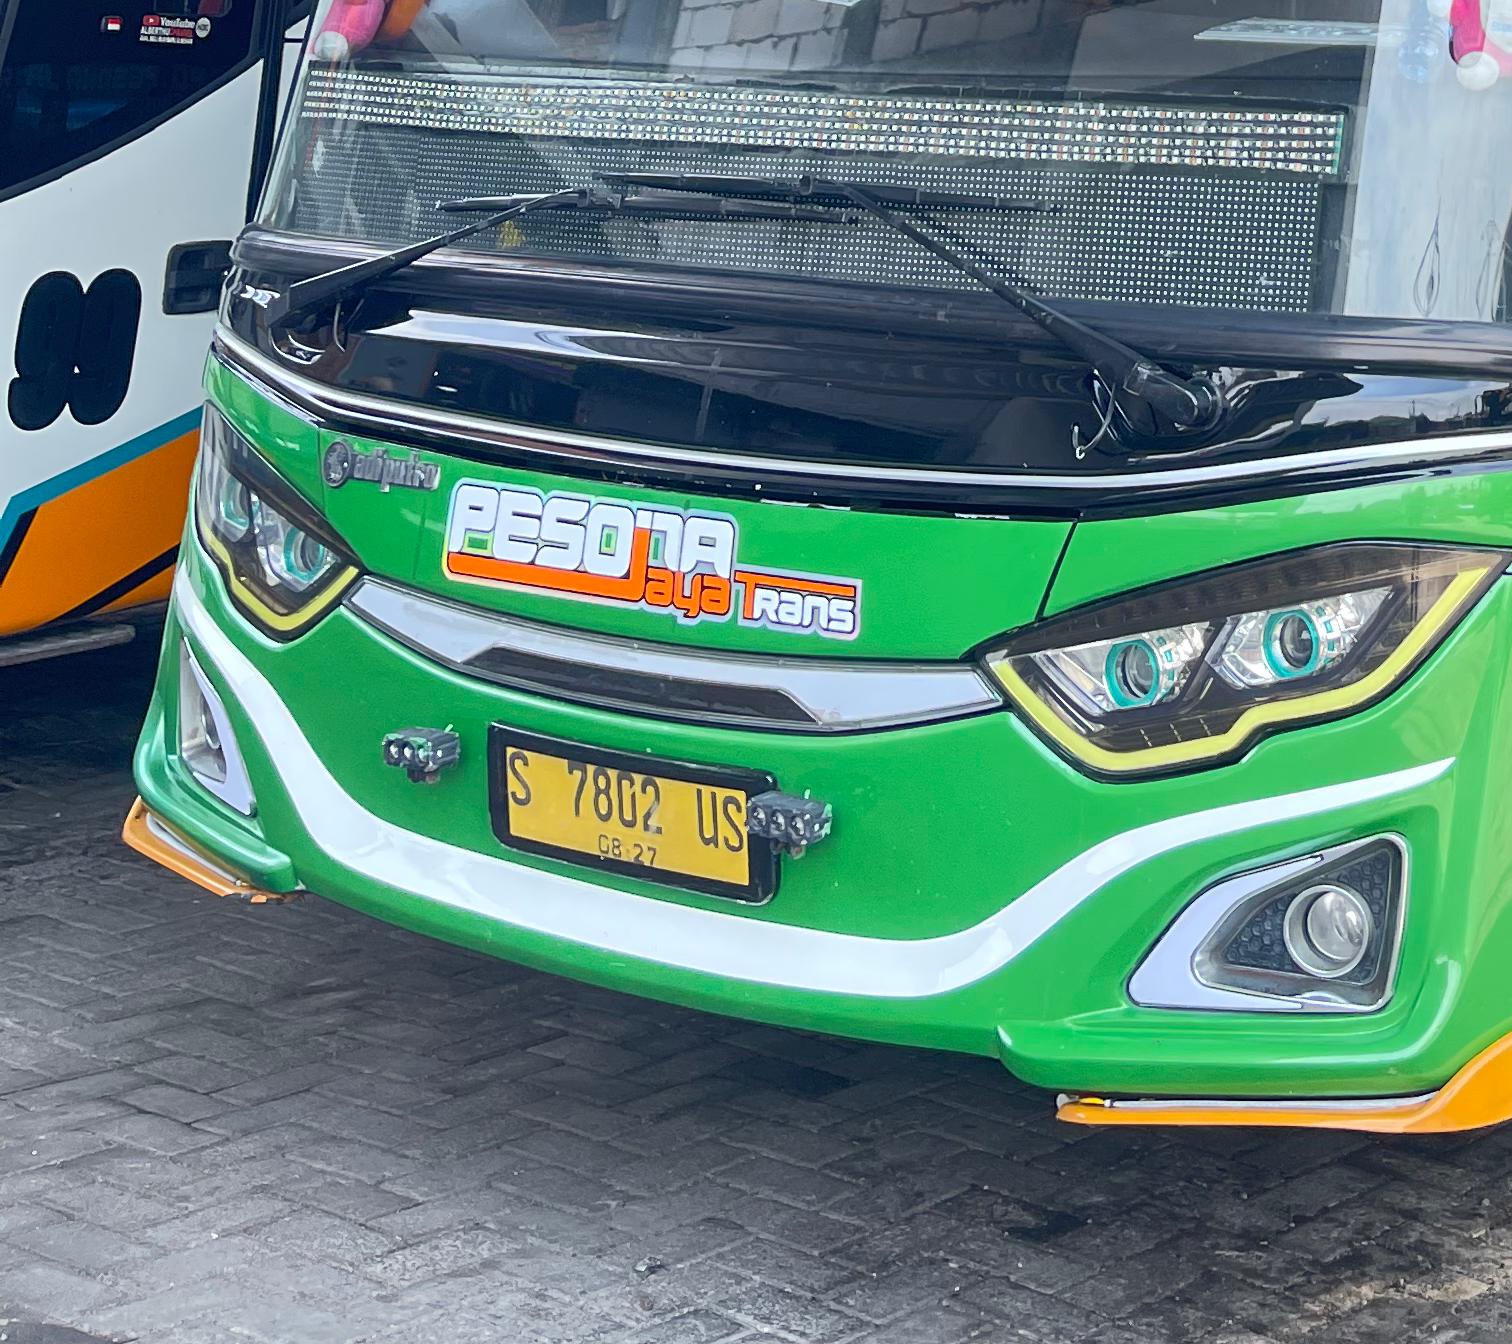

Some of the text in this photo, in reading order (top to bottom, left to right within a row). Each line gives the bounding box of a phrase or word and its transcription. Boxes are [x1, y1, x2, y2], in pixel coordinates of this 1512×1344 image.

[160, 16, 196, 30] YouTube
[447, 483, 736, 579] PESONA
[507, 750, 745, 853] S 7802 US
